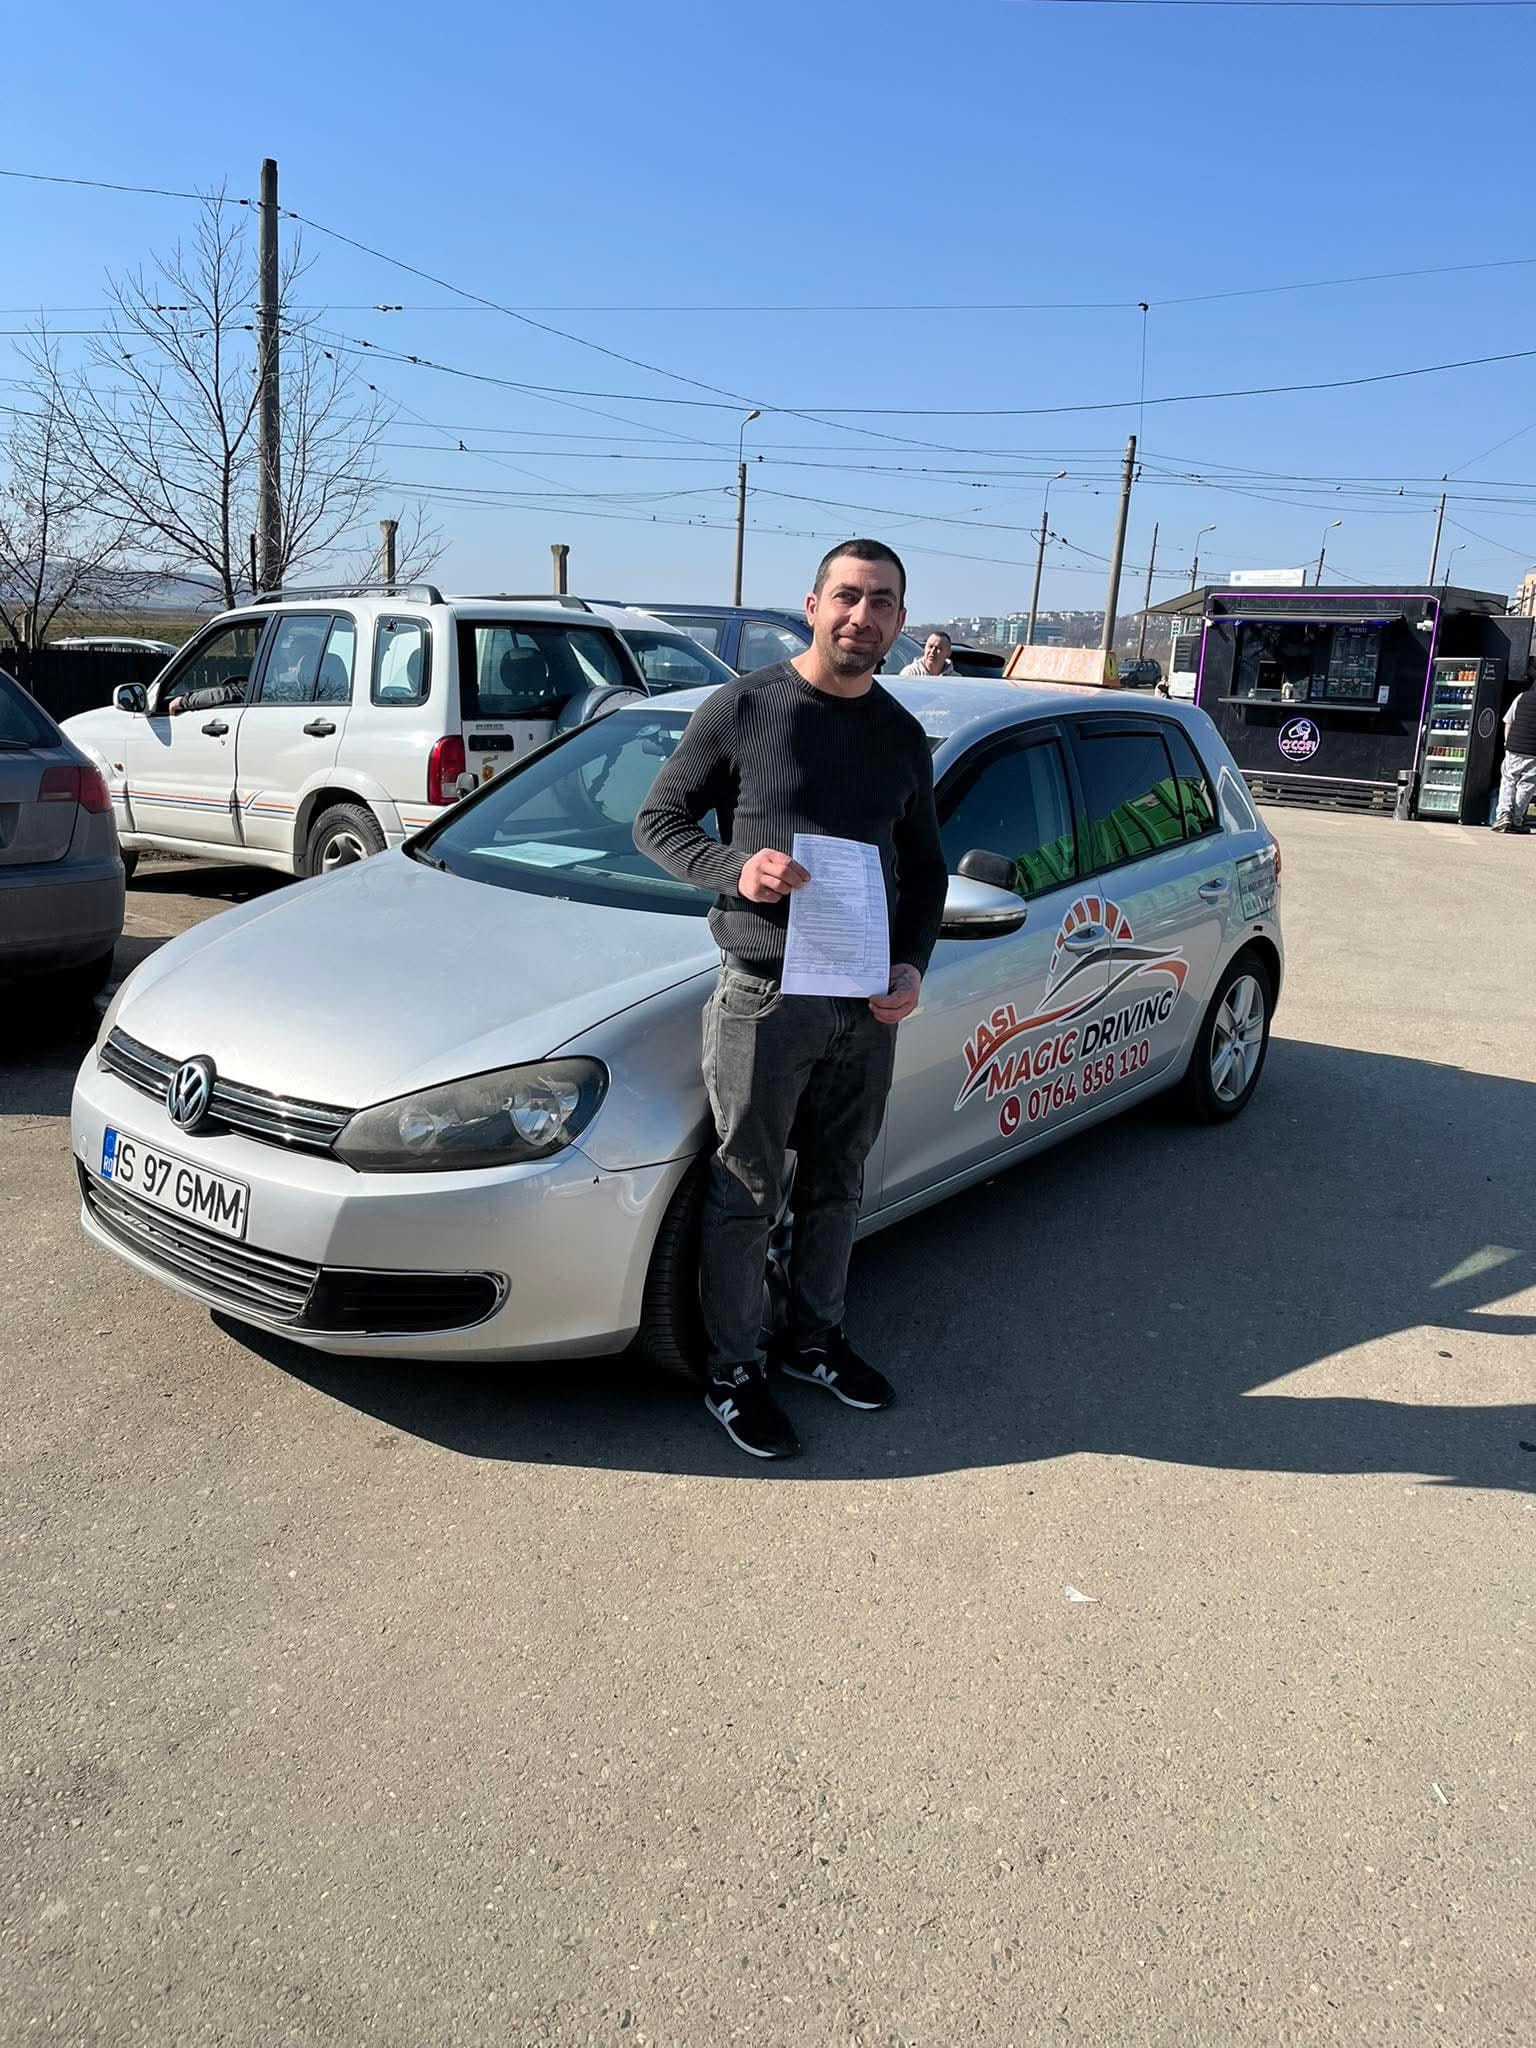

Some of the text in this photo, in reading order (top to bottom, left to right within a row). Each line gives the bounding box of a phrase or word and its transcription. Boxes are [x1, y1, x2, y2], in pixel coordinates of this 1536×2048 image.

[963, 1004, 1017, 1069] IASI
[987, 990, 1175, 1101] MAGIC DRIVING
[1027, 1039, 1150, 1121] 0764 858 120
[114, 1140, 241, 1230] IS 97 GMM
[812, 1363, 840, 1385] N
[717, 1397, 741, 1426] N
